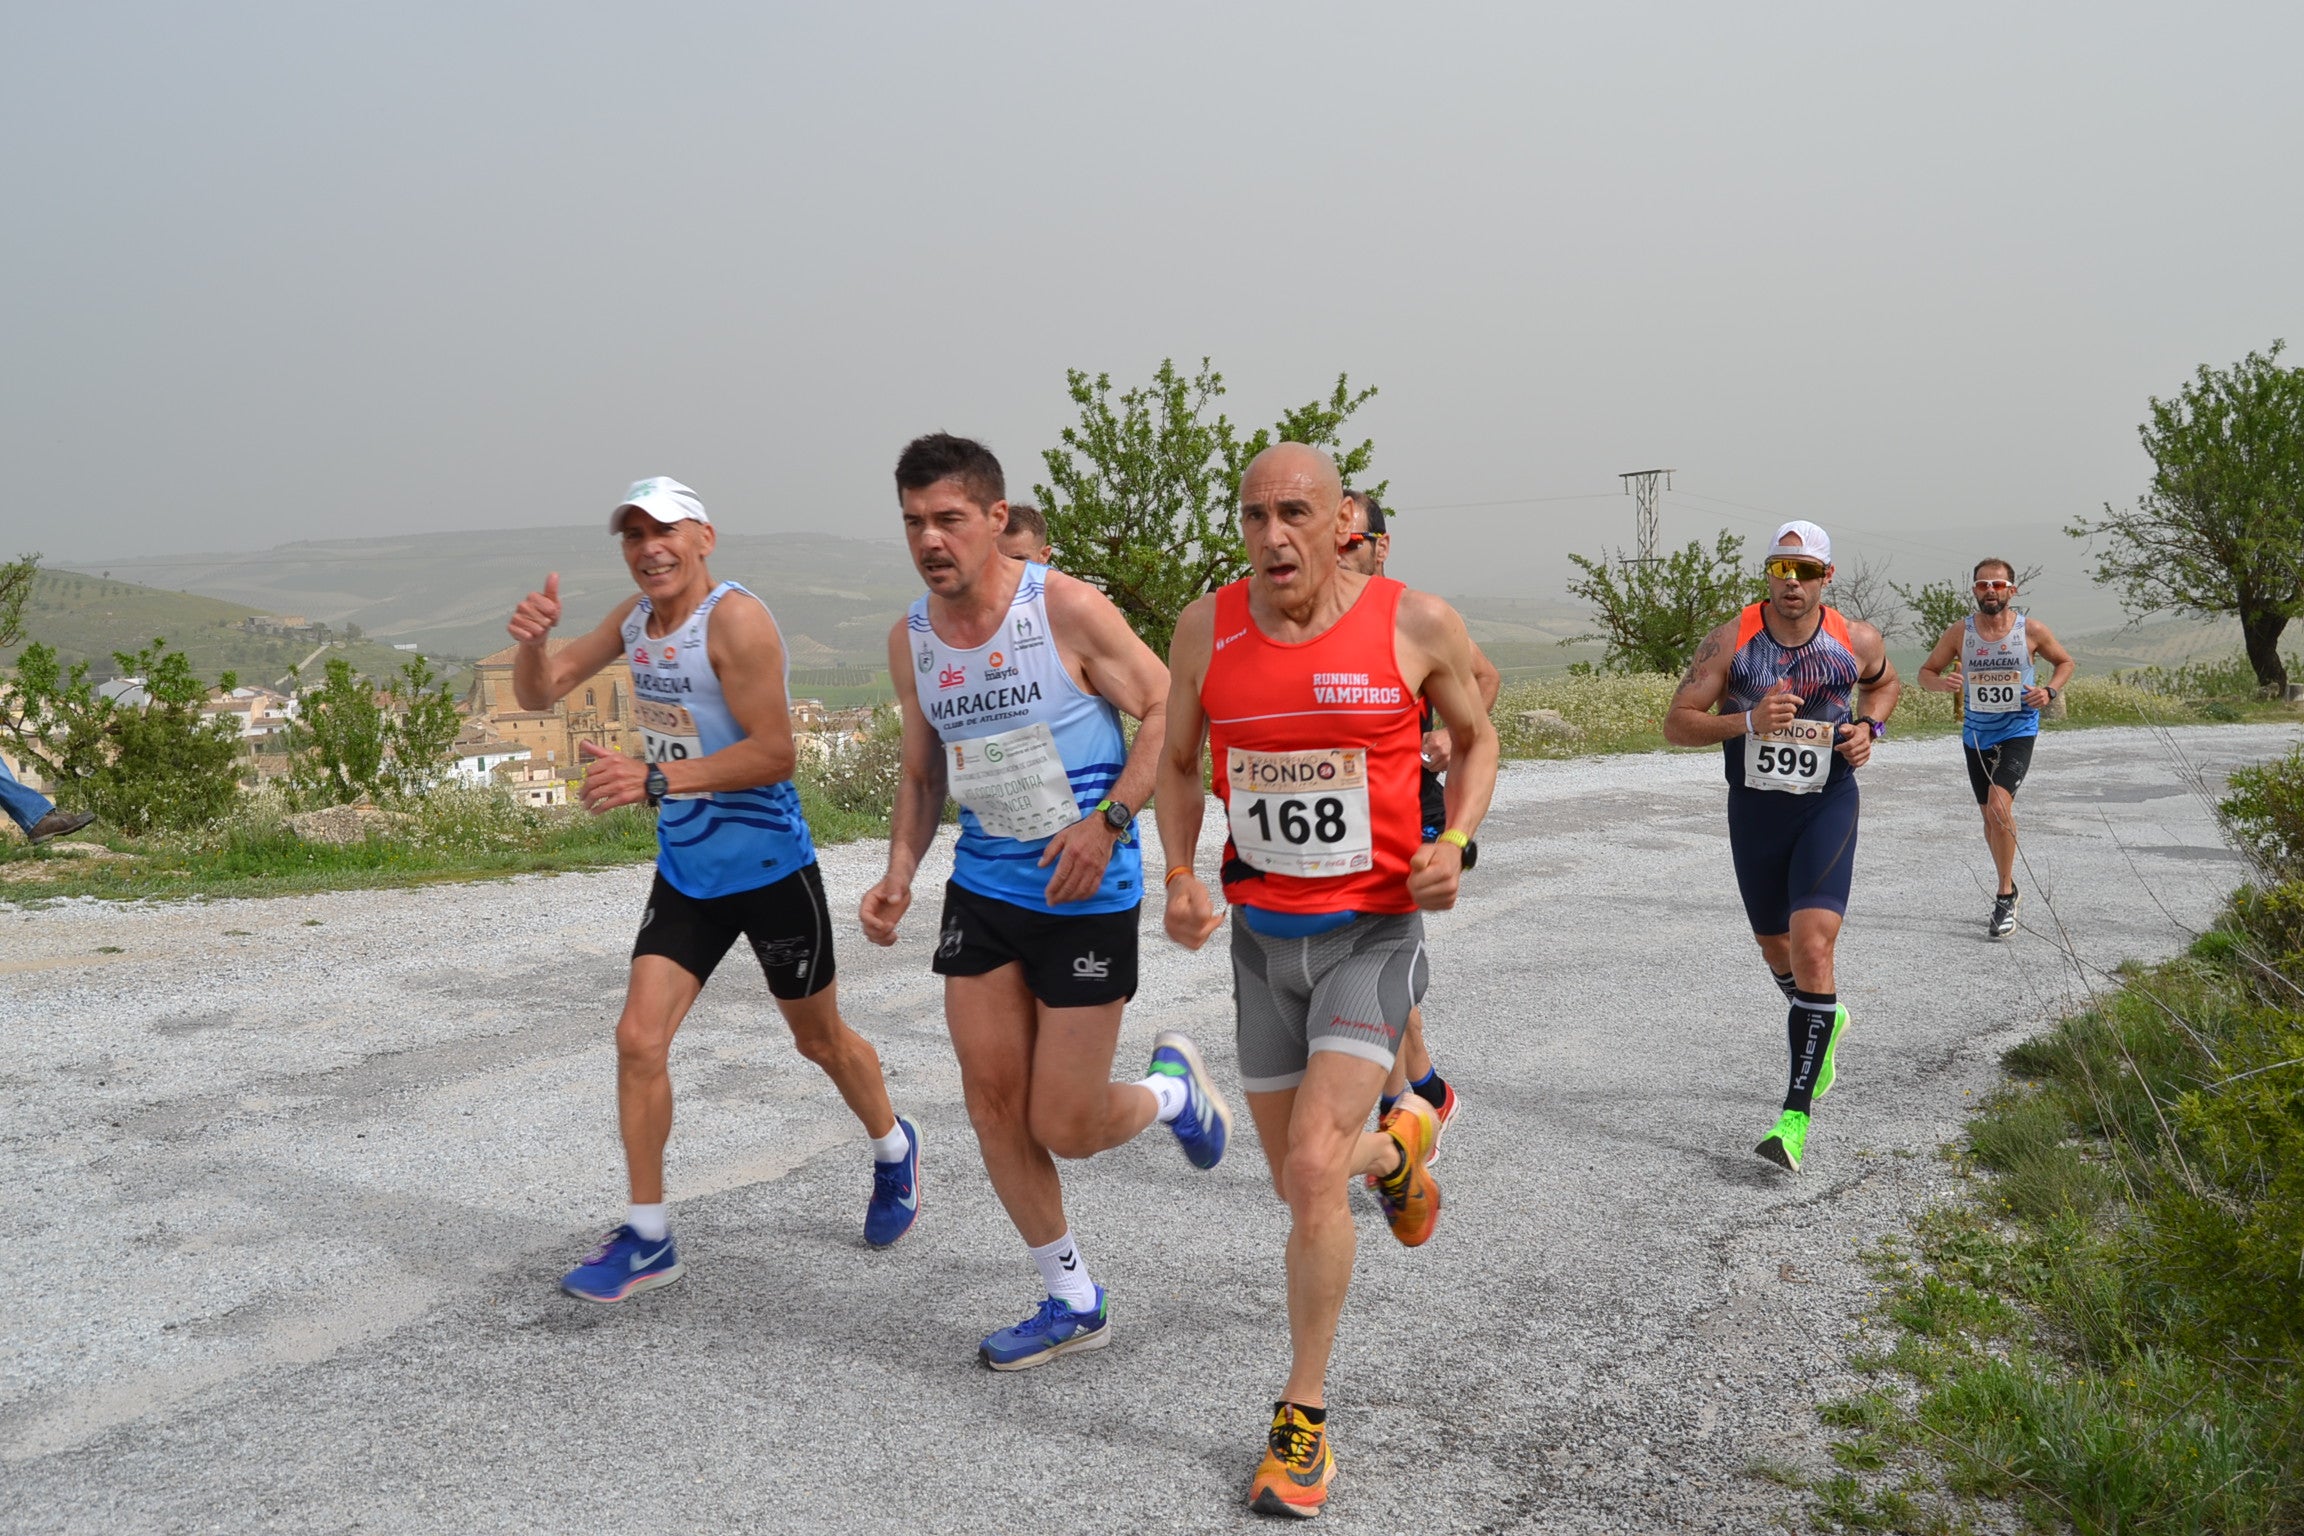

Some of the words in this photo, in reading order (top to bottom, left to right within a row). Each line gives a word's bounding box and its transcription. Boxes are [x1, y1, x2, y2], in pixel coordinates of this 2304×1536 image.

[1968, 657, 2020, 668] MARACENA
[1313, 673, 1369, 686] RUNNING
[1979, 673, 2011, 682] FONDO
[930, 681, 1042, 721] MARACENA
[1313, 687, 1401, 704] VAMPIROS
[1977, 686, 2013, 703] 630
[966, 717, 977, 725] DE
[979, 708, 1030, 724] ATLETISMO
[1756, 746, 1818, 777] 599
[1251, 762, 1336, 782] FONDO
[1004, 774, 1044, 796] CONTRA
[1248, 798, 1347, 845] 168
